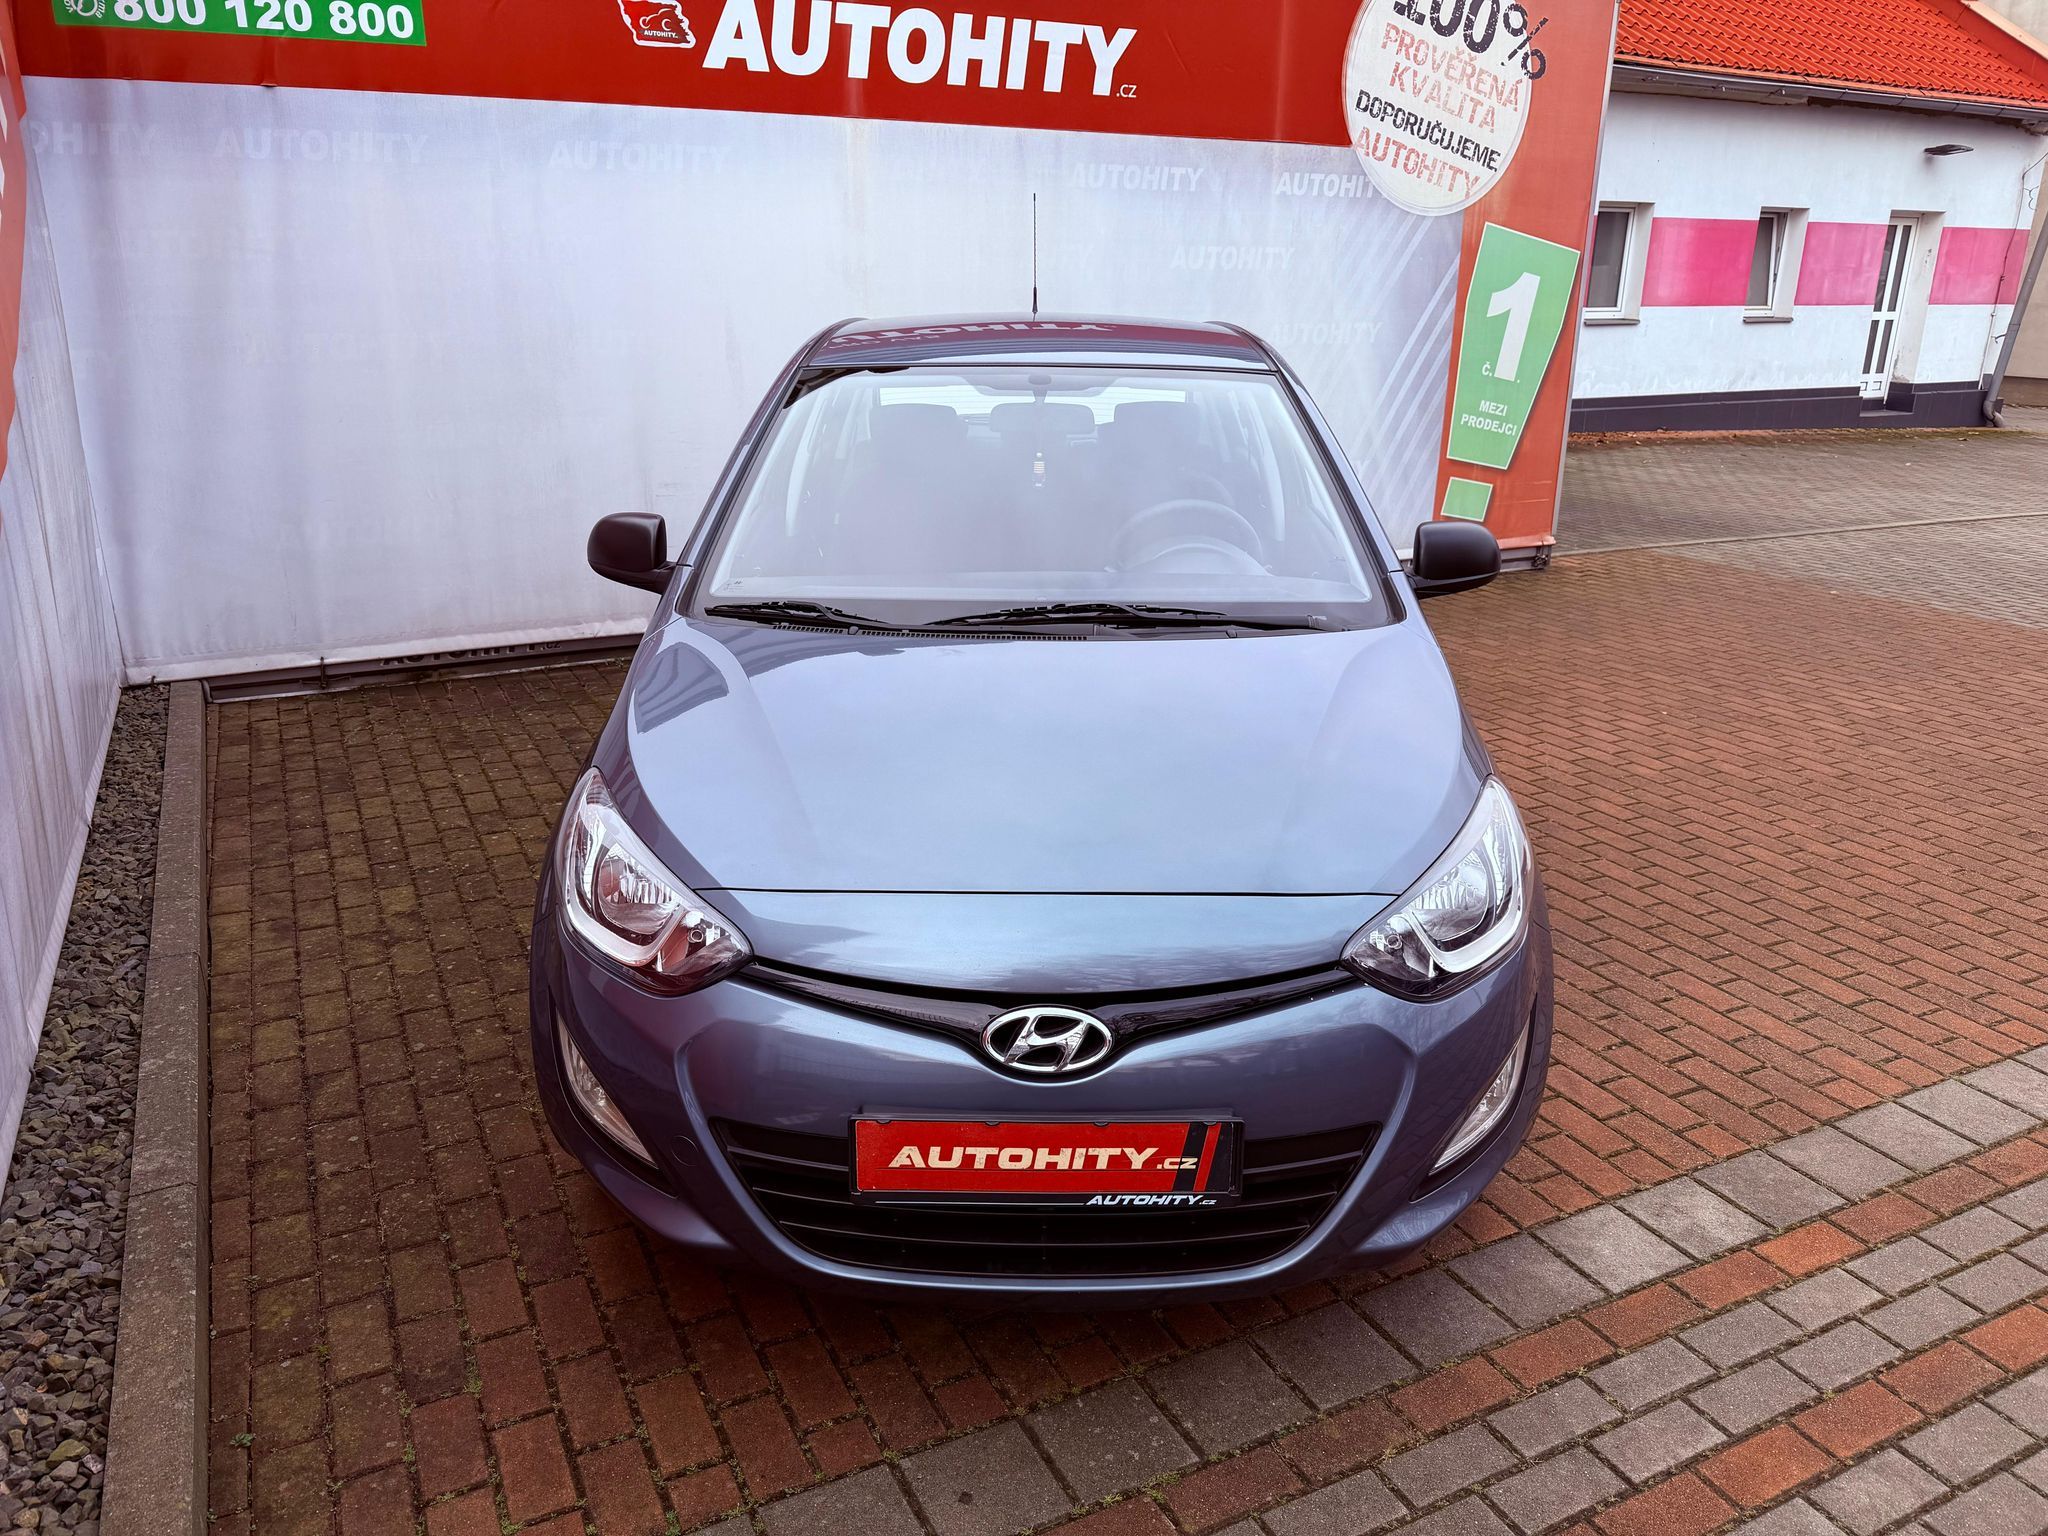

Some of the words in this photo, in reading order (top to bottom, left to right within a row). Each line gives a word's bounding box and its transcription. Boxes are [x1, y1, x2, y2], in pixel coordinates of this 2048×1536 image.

[114, 0, 206, 25] 800
[225, 0, 312, 32] 120
[328, 0, 414, 38] 800
[1381, 22, 1522, 112] PROVĚŘENÁ
[1389, 61, 1495, 133] KVALITA
[212, 127, 429, 163] AUTOHITY
[1355, 89, 1501, 172] DOPORUČUJEME
[549, 139, 731, 174] AUTOHITY
[1352, 127, 1481, 200] AUTOHITY
[1071, 163, 1204, 192] AUTOHITY
[1275, 172, 1386, 199] AUTOHIT
[1169, 245, 1295, 270] AUTOHITY
[1270, 322, 1382, 344] AUTOHITY
[1479, 400, 1507, 416] MEZI
[1460, 414, 1517, 436] PRODEJCI
[888, 1146, 1198, 1169] AUTOHITY.cz
